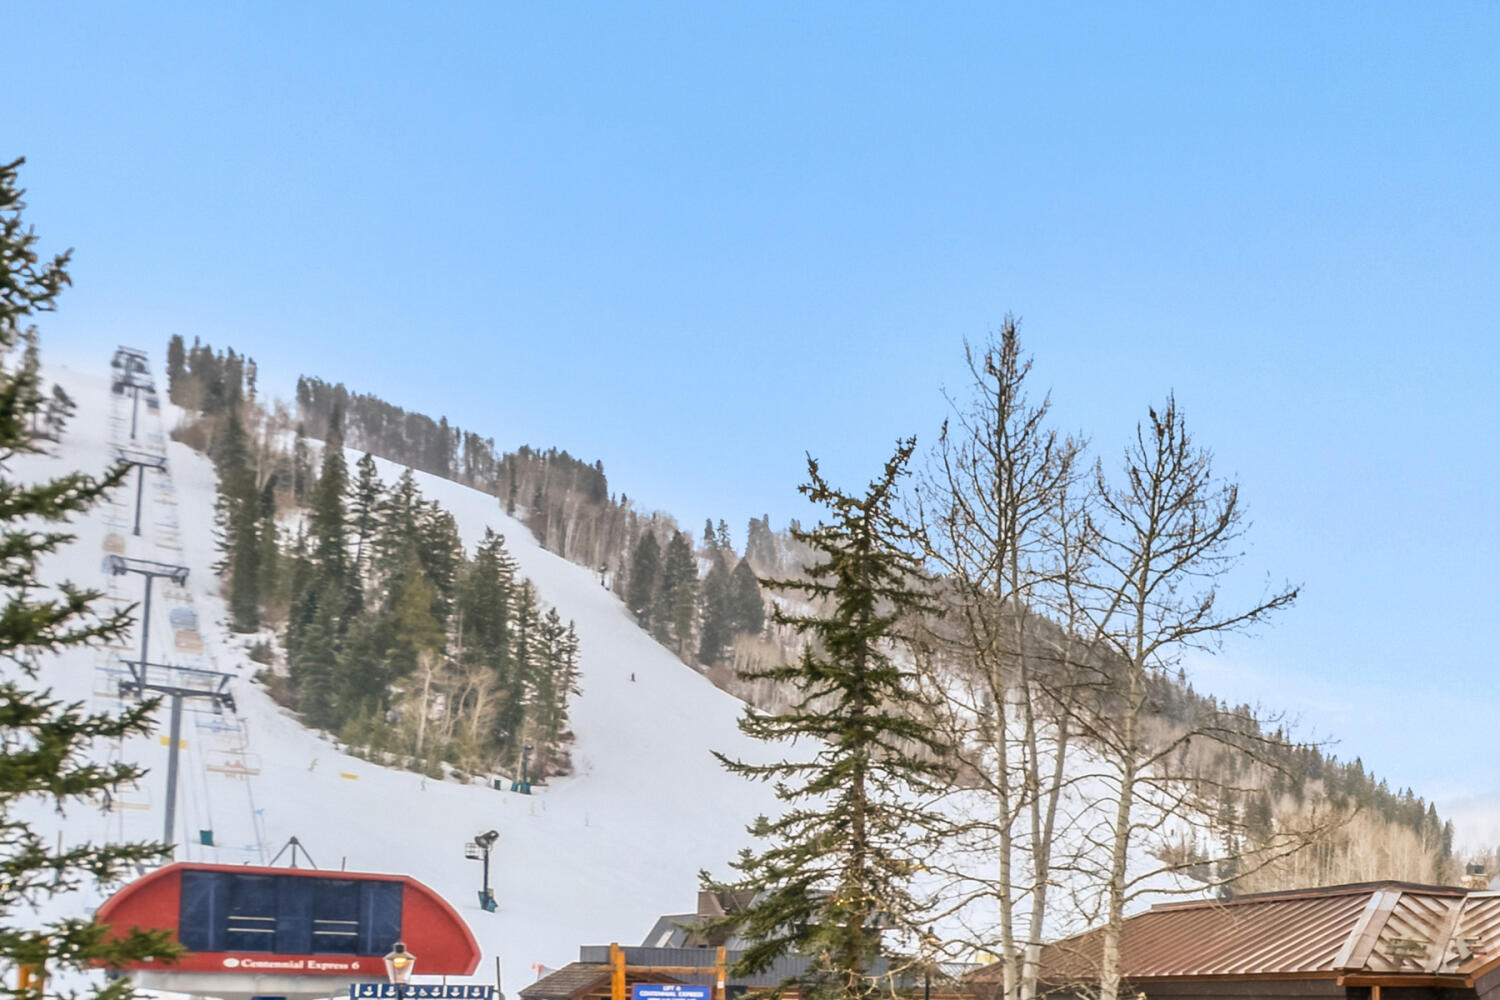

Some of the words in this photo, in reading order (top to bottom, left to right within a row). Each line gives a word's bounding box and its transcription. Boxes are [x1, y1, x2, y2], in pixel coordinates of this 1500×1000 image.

[240, 958, 304, 969] Centennial
[307, 960, 349, 971] Express
[351, 961, 360, 970] 6
